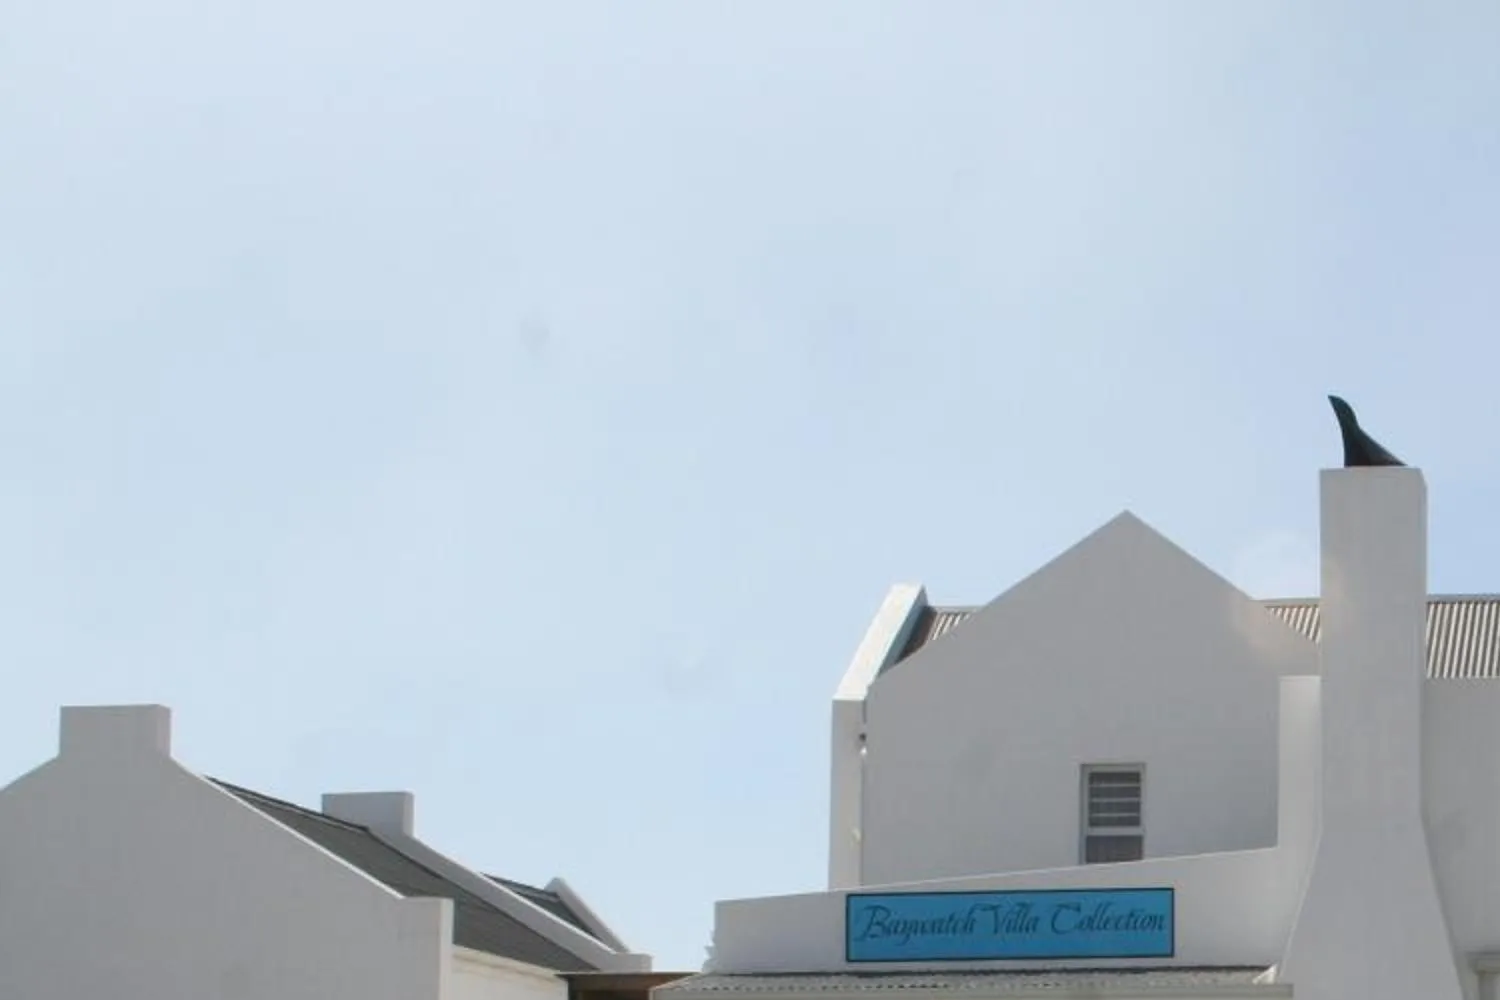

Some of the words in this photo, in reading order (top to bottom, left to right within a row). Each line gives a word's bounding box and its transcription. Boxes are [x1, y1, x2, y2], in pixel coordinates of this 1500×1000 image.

[854, 903, 982, 946] Baywatch
[977, 902, 1040, 936] Villa
[1050, 901, 1166, 934] Collection
